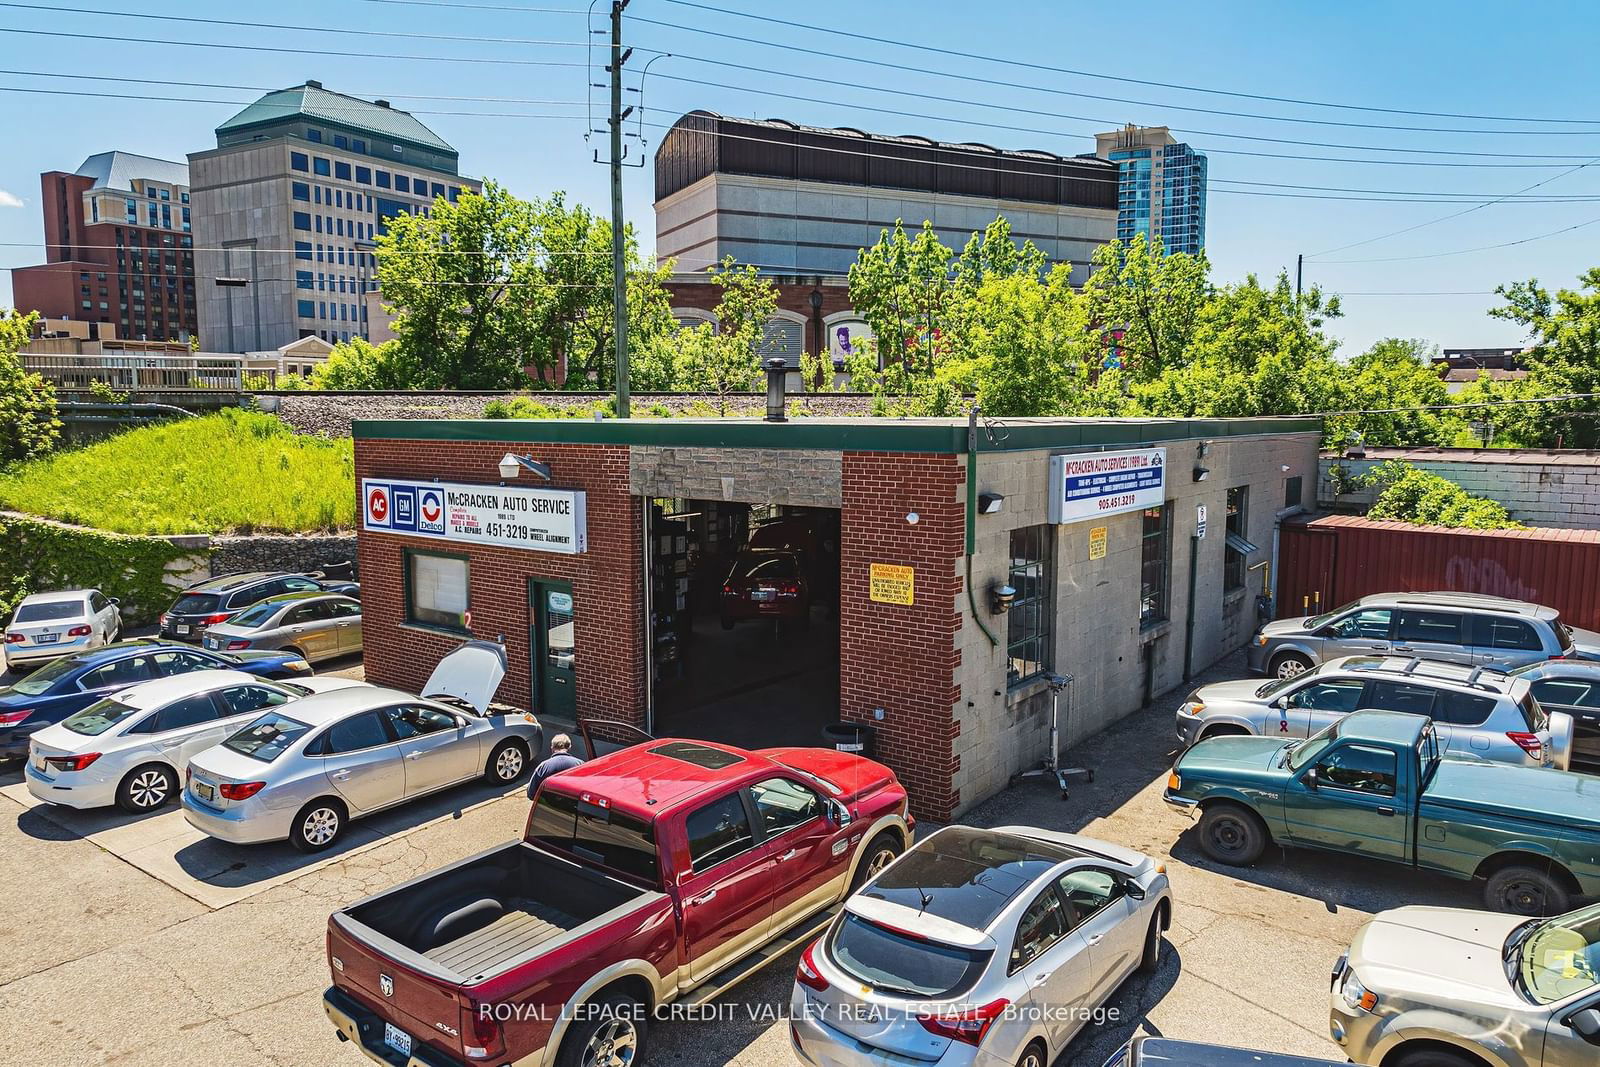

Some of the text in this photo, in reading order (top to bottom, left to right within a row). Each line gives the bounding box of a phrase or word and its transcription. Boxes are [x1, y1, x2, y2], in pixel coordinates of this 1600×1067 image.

[1095, 459, 1107, 472] AUTO
[1108, 457, 1127, 470] SERVICES
[373, 499, 384, 512] AC
[400, 499, 410, 512] GM
[448, 492, 570, 515] McCRACKEN AUTO SERVICE
[1098, 494, 1135, 510] 905.451.3219
[421, 521, 442, 530] Delco
[464, 526, 482, 535] REPAIRS
[486, 522, 528, 540] 451-3219
[530, 533, 544, 542] WHEEL
[546, 534, 570, 544] ALIGNMENT
